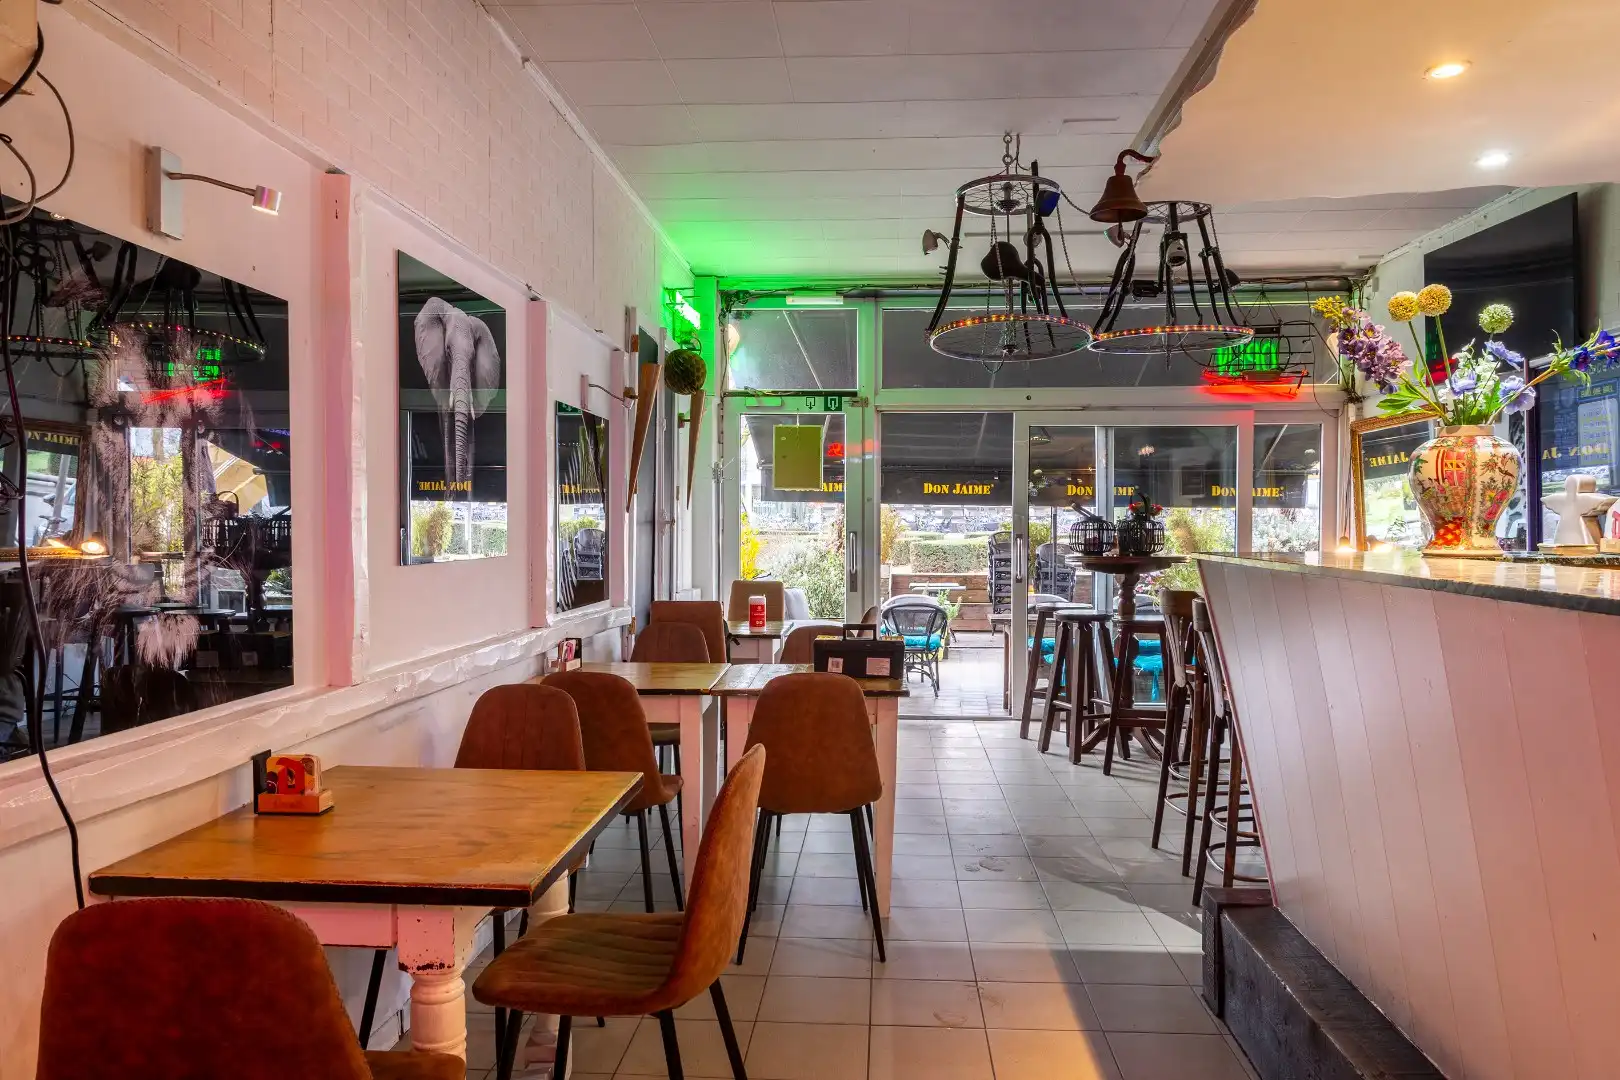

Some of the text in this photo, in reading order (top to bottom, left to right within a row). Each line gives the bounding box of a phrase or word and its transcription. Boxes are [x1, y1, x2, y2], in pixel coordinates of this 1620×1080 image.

[822, 482, 843, 492] AIM
[923, 482, 950, 494] DON
[1067, 484, 1093, 496] DON
[1212, 485, 1281, 497] DON AIME
